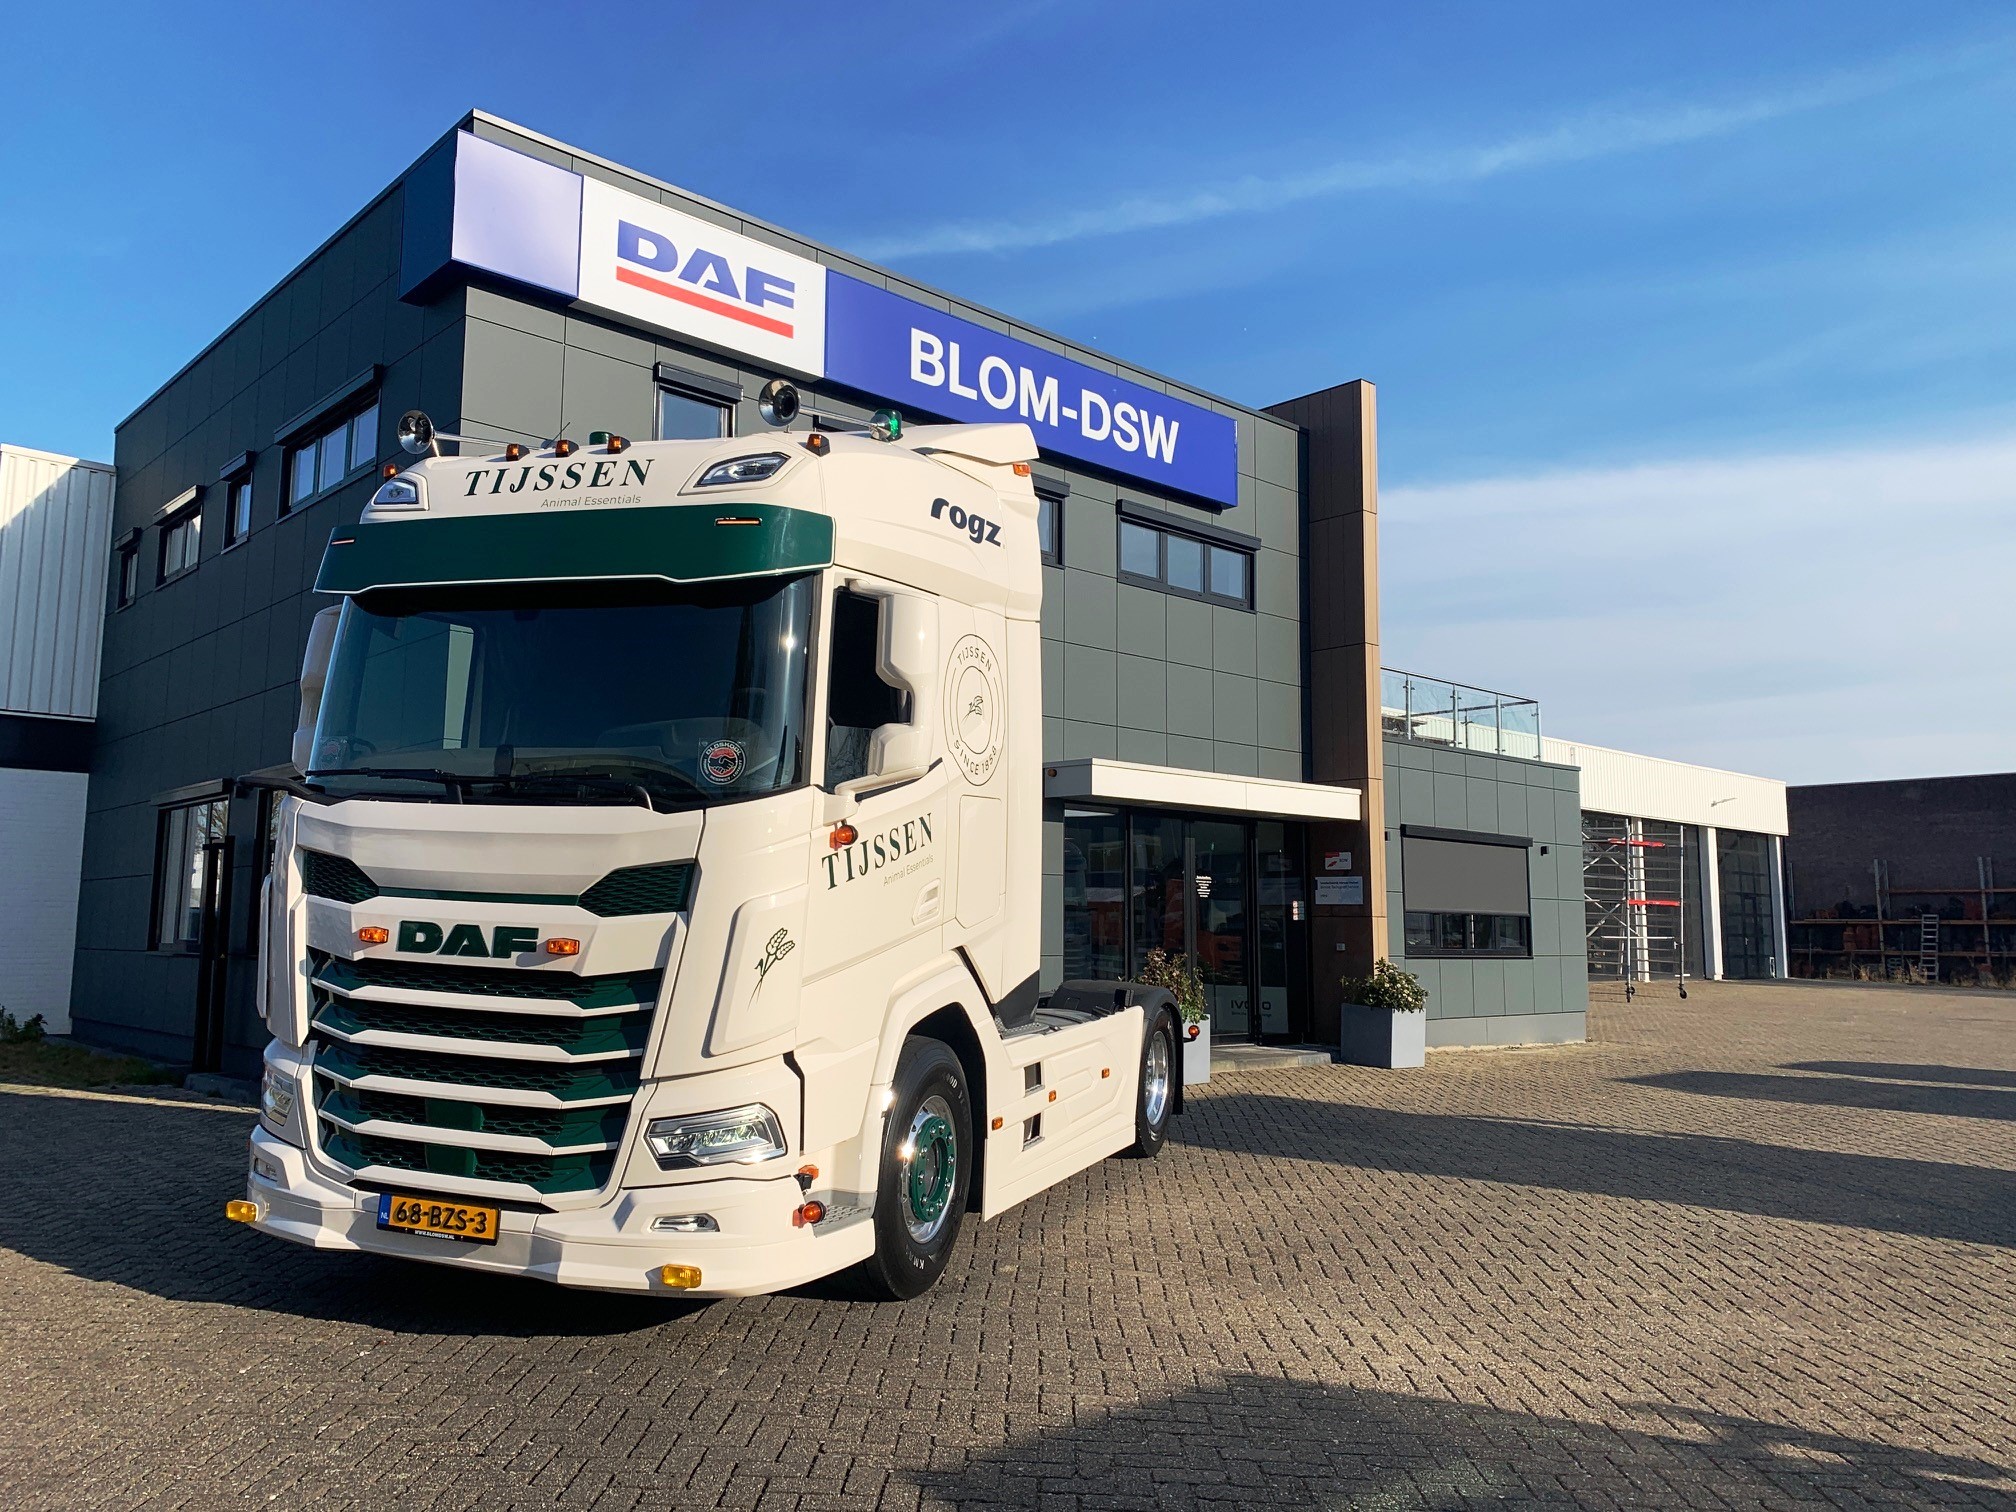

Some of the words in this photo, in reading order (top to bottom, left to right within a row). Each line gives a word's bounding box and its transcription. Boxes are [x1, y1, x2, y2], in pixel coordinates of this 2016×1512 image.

[617, 219, 795, 309] DAF
[910, 327, 1180, 464] BLOM-DSW
[464, 458, 655, 497] TIJSSEN
[541, 497, 581, 508] Animal
[584, 494, 642, 506] Essentials
[930, 497, 1002, 548] rogz
[956, 645, 993, 672] TIJSSEN
[953, 739, 979, 776] SINCE
[821, 812, 933, 891] TIJSSEN
[883, 870, 906, 887] Animal
[906, 854, 934, 875] Essentials
[396, 920, 540, 958] DAF
[380, 1211, 389, 1220] NL
[393, 1201, 487, 1234] 68-BZS-3
